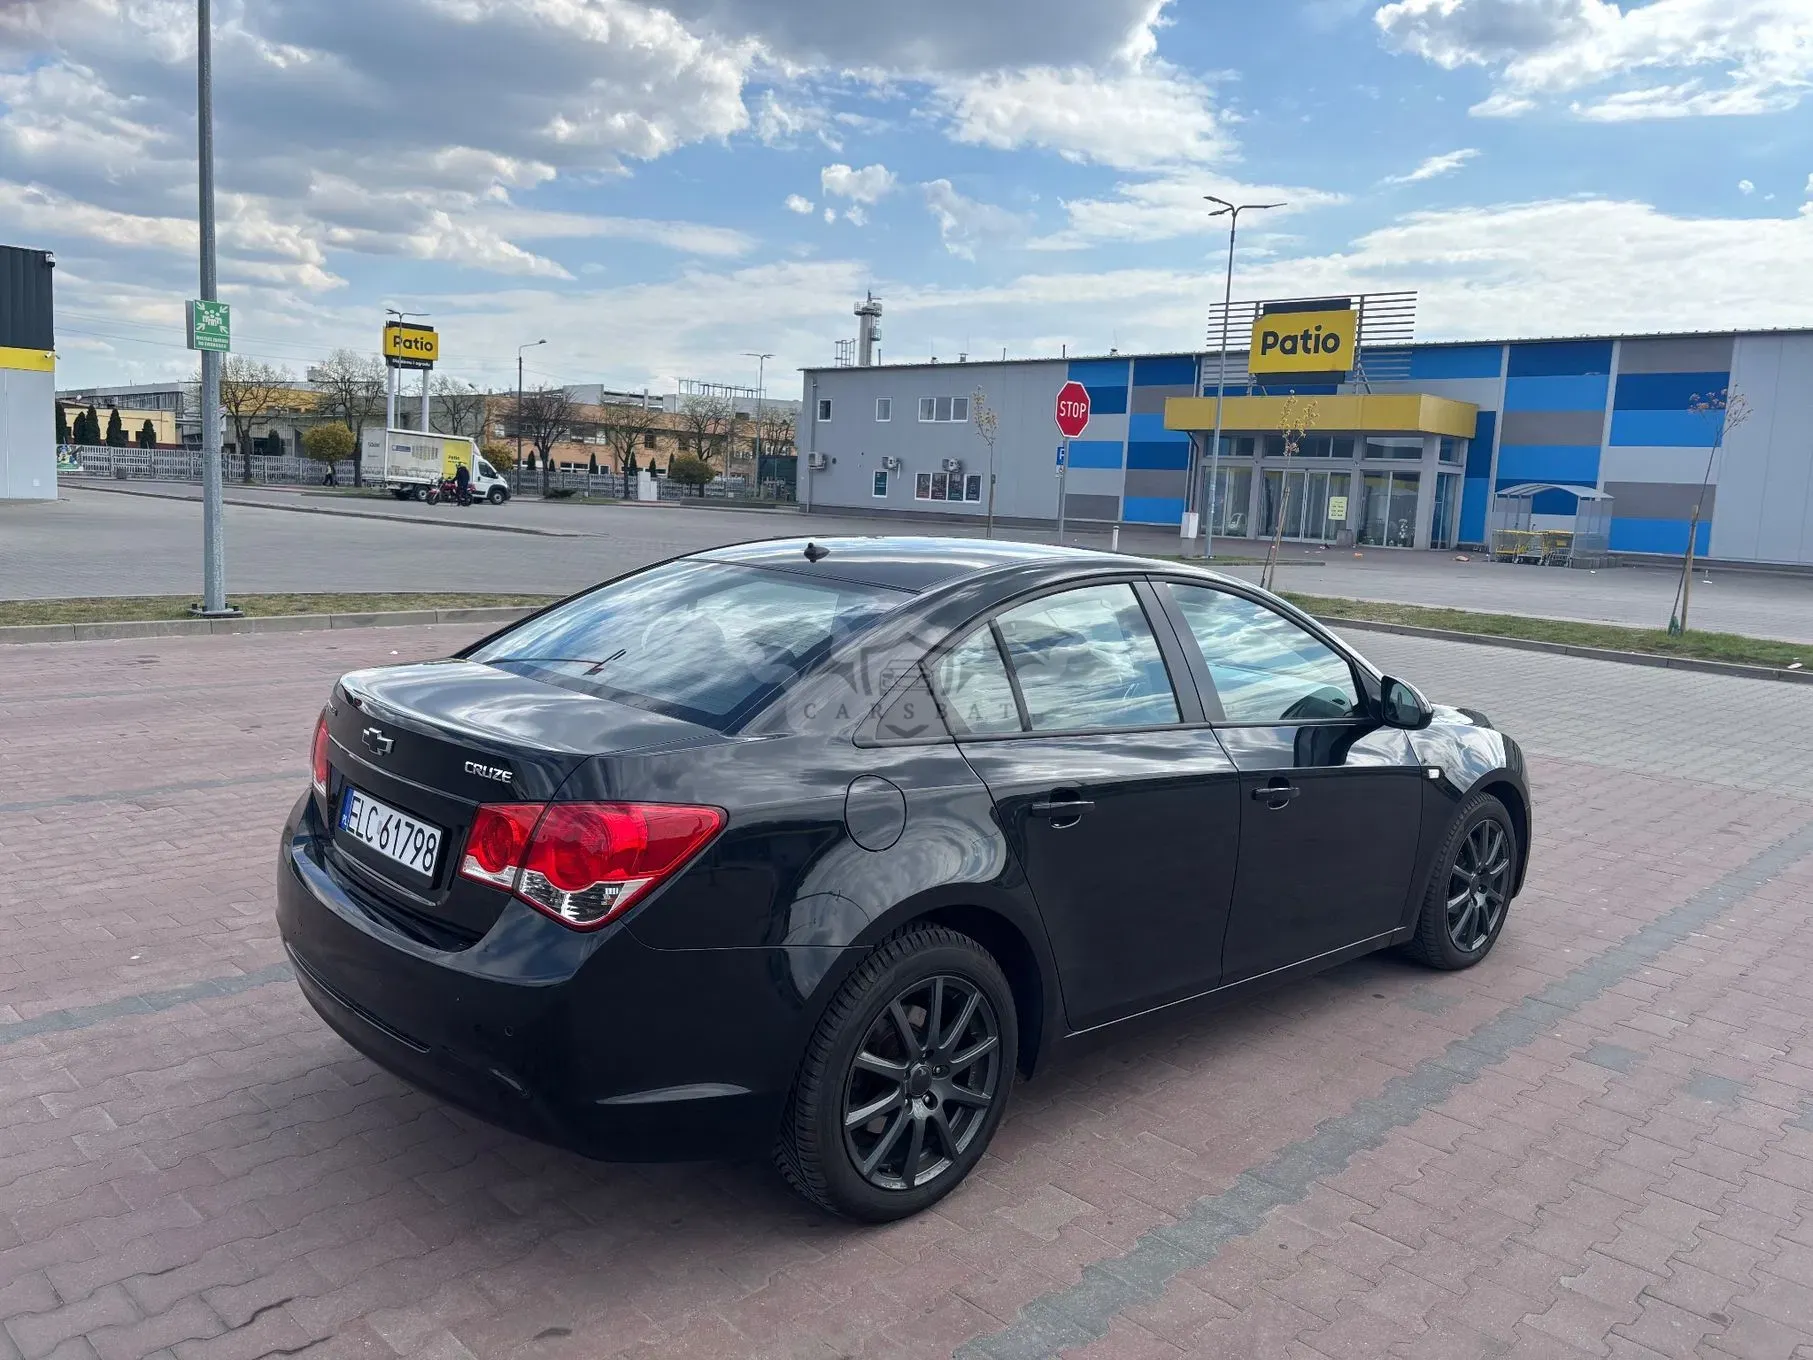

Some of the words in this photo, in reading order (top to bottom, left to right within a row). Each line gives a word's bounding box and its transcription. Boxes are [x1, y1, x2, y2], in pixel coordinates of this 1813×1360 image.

[393, 335, 433, 352] Patio
[1261, 325, 1340, 355] Patio
[1059, 401, 1087, 419] STOP
[464, 761, 513, 784] CRUZE
[346, 795, 379, 843] ELC
[379, 814, 437, 873] 61798
